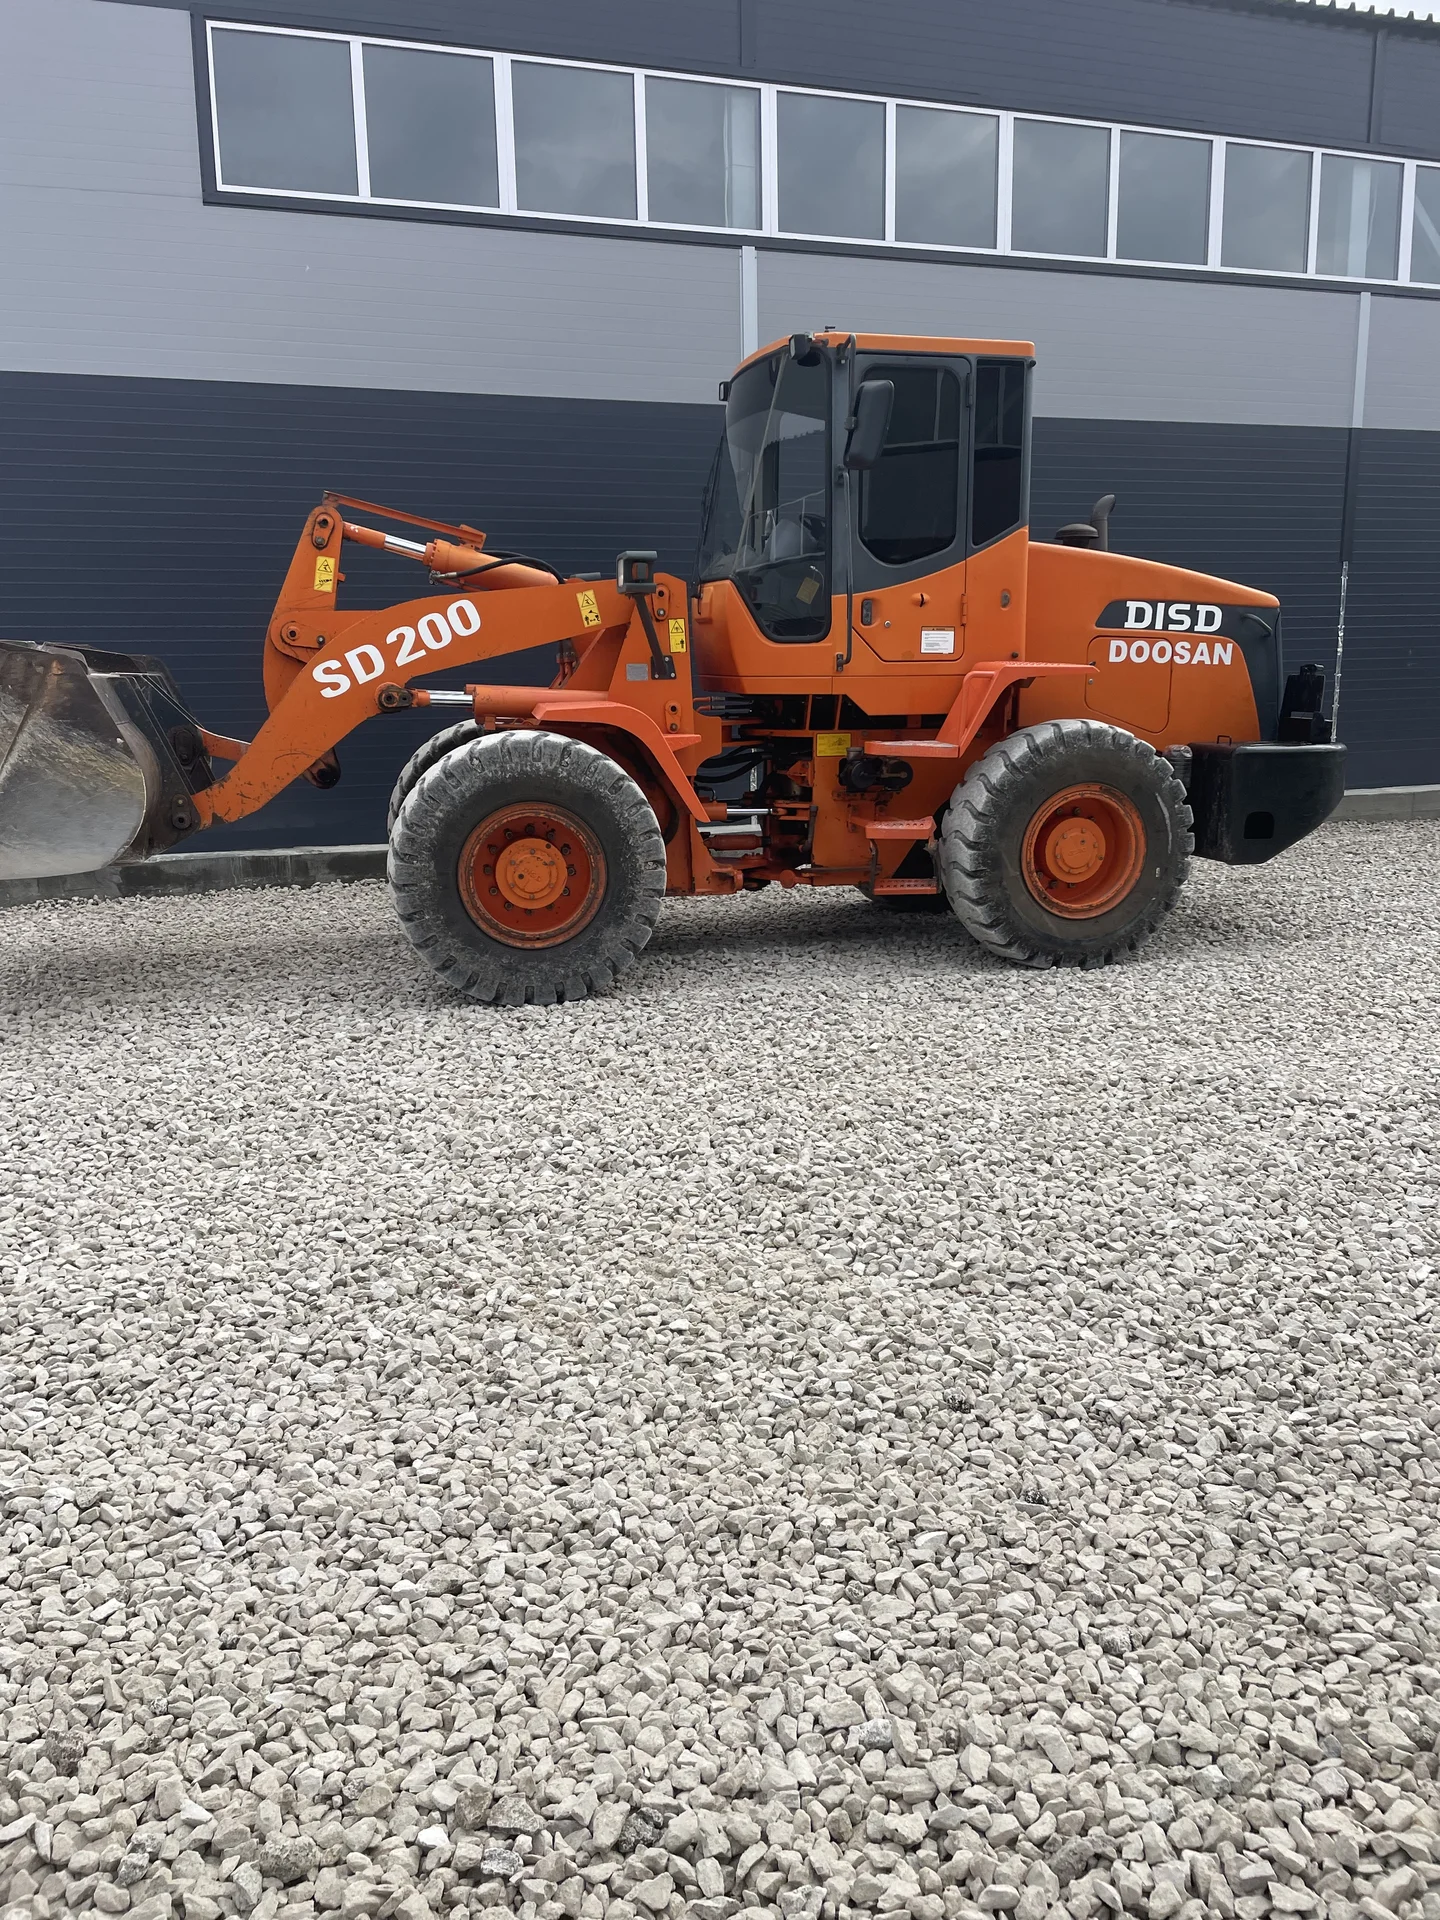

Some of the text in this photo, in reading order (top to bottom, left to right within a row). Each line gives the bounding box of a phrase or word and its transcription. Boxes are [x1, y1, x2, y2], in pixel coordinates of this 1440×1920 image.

[1124, 600, 1223, 632] DISD
[312, 599, 482, 699] SD 200
[1108, 639, 1234, 666] DOOSAN
